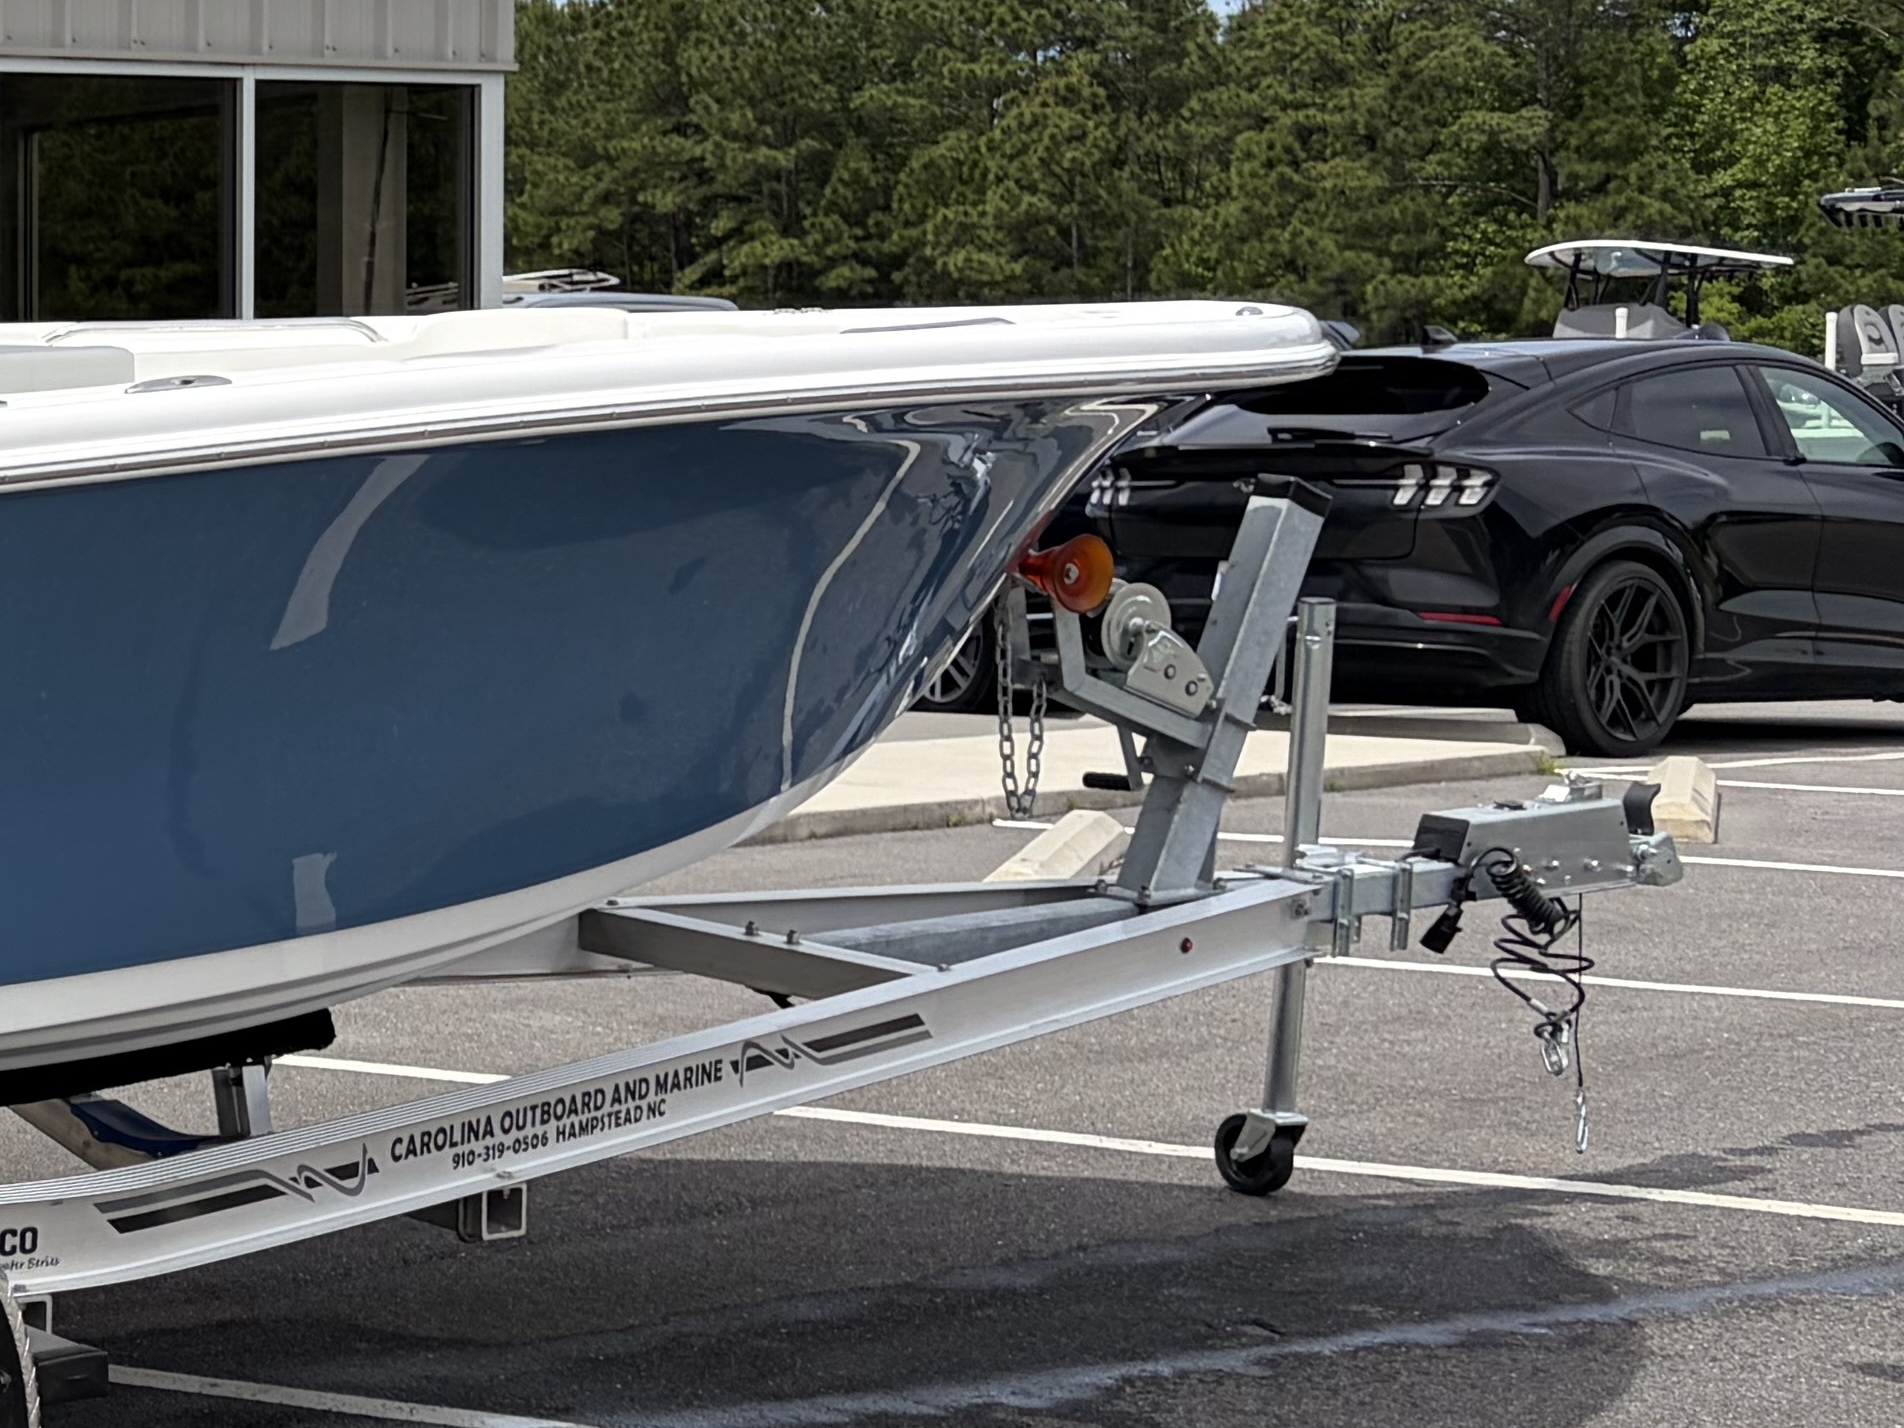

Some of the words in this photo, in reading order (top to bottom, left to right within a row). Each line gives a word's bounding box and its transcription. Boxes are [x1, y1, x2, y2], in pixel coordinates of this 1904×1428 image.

[390, 1115, 495, 1163] CAROLINA
[499, 1087, 605, 1135] OUTBOARD
[609, 1076, 650, 1108] AND
[654, 1058, 723, 1095] MARINE
[451, 1132, 550, 1170] 910-319-0506
[555, 1104, 644, 1144] HAMPSTEAD
[646, 1098, 667, 1119] NC
